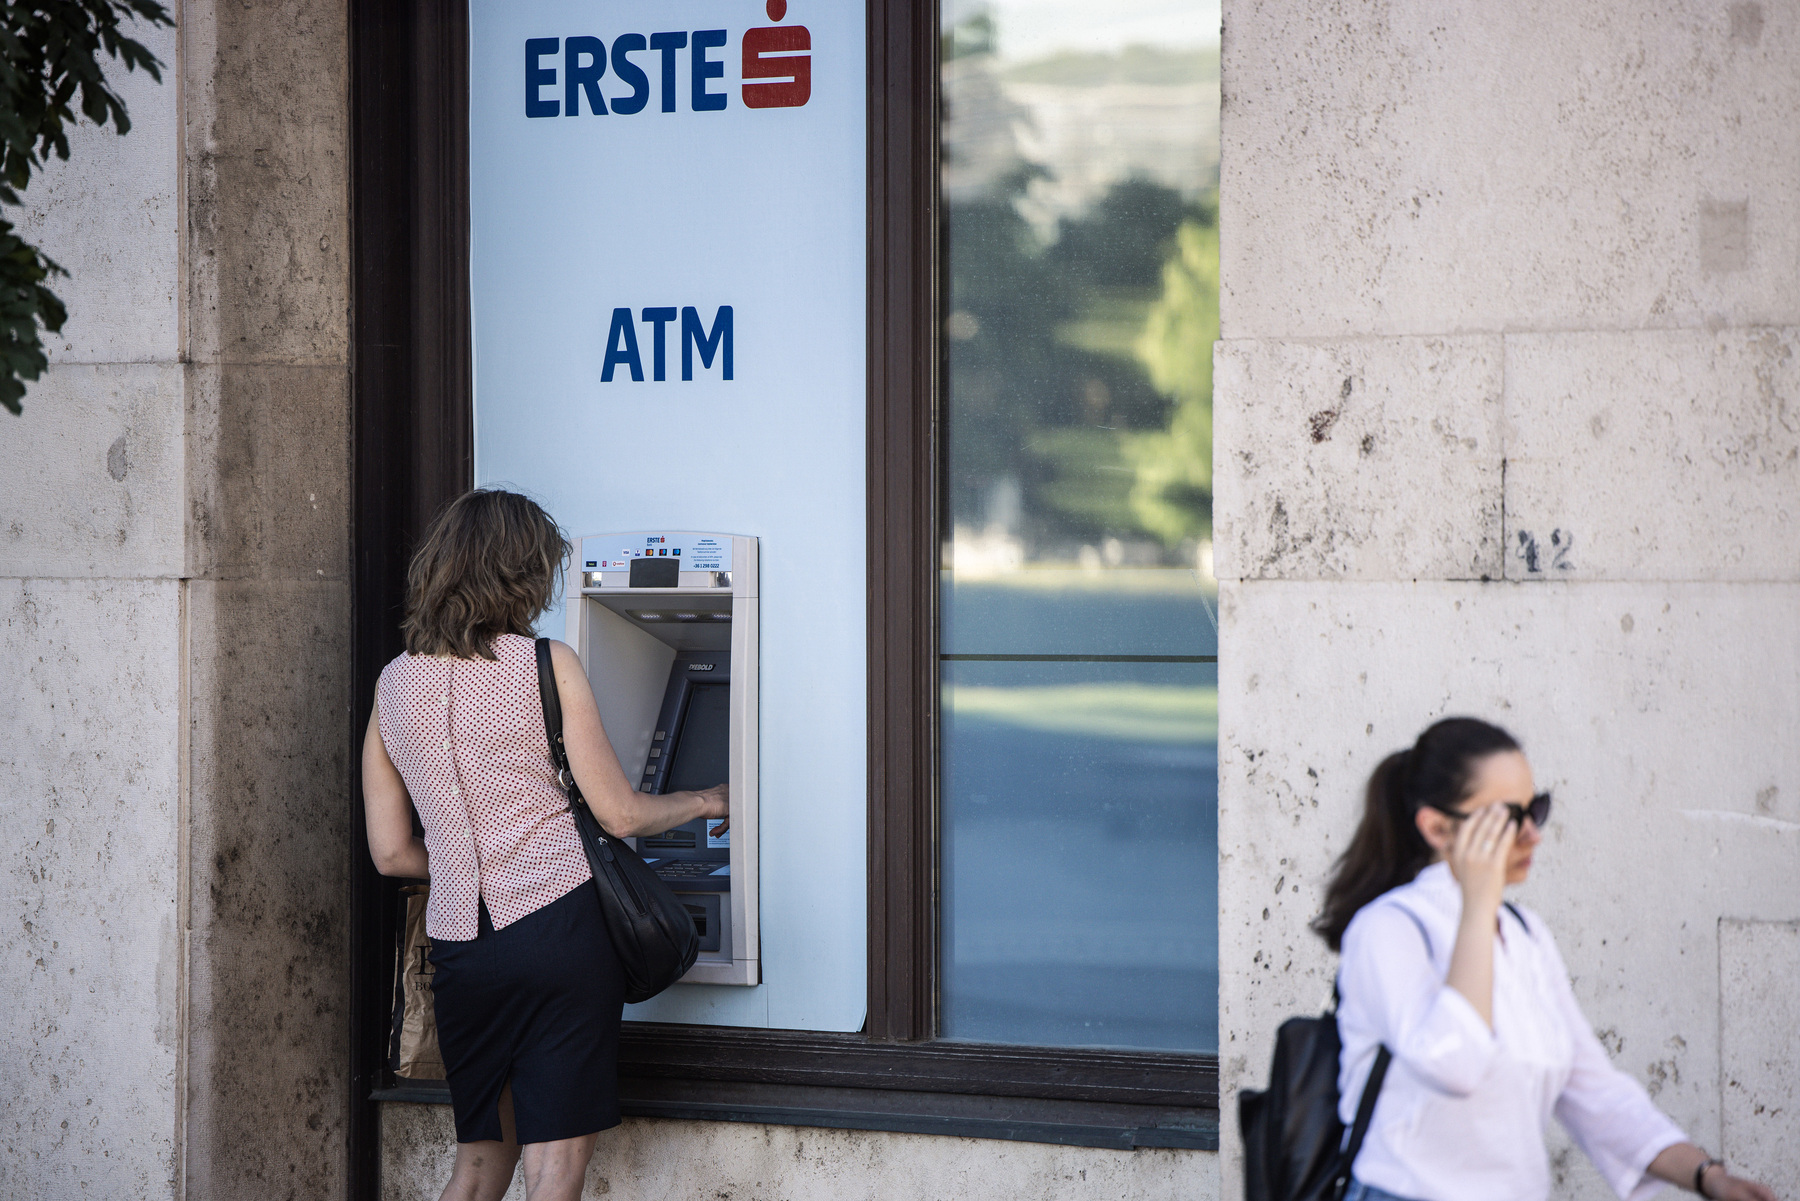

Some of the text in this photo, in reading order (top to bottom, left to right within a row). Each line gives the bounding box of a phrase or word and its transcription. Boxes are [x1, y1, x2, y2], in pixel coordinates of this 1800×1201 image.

[525, 29, 727, 118] ERSTE
[600, 305, 734, 382] ATM
[415, 982, 432, 991] BO
